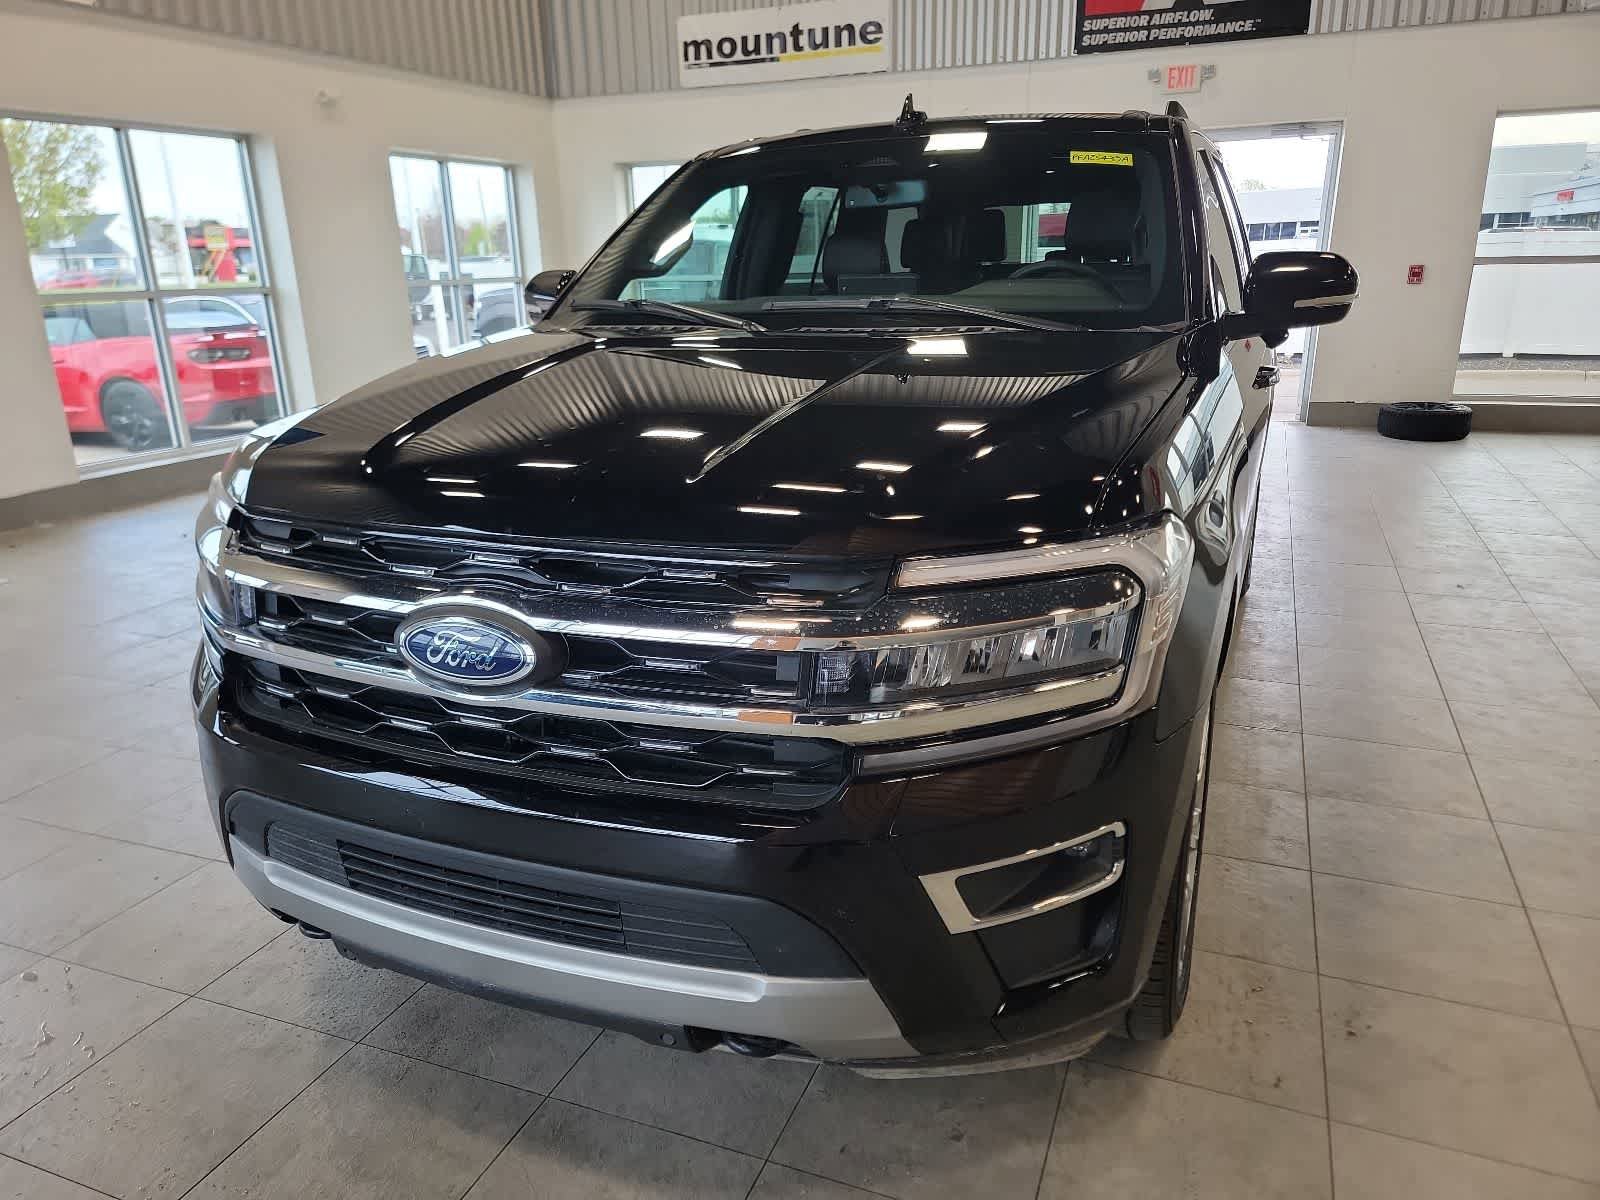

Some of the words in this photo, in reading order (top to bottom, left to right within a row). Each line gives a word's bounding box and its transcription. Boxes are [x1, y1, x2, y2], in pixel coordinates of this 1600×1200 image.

[1083, 15, 1149, 31] SUPERIOR
[1150, 9, 1214, 25] AIRFLOW.
[683, 20, 883, 62] mountune
[1082, 29, 1147, 46] SUPERIOR
[1168, 65, 1197, 89] EXIT
[426, 630, 496, 671] Ford
